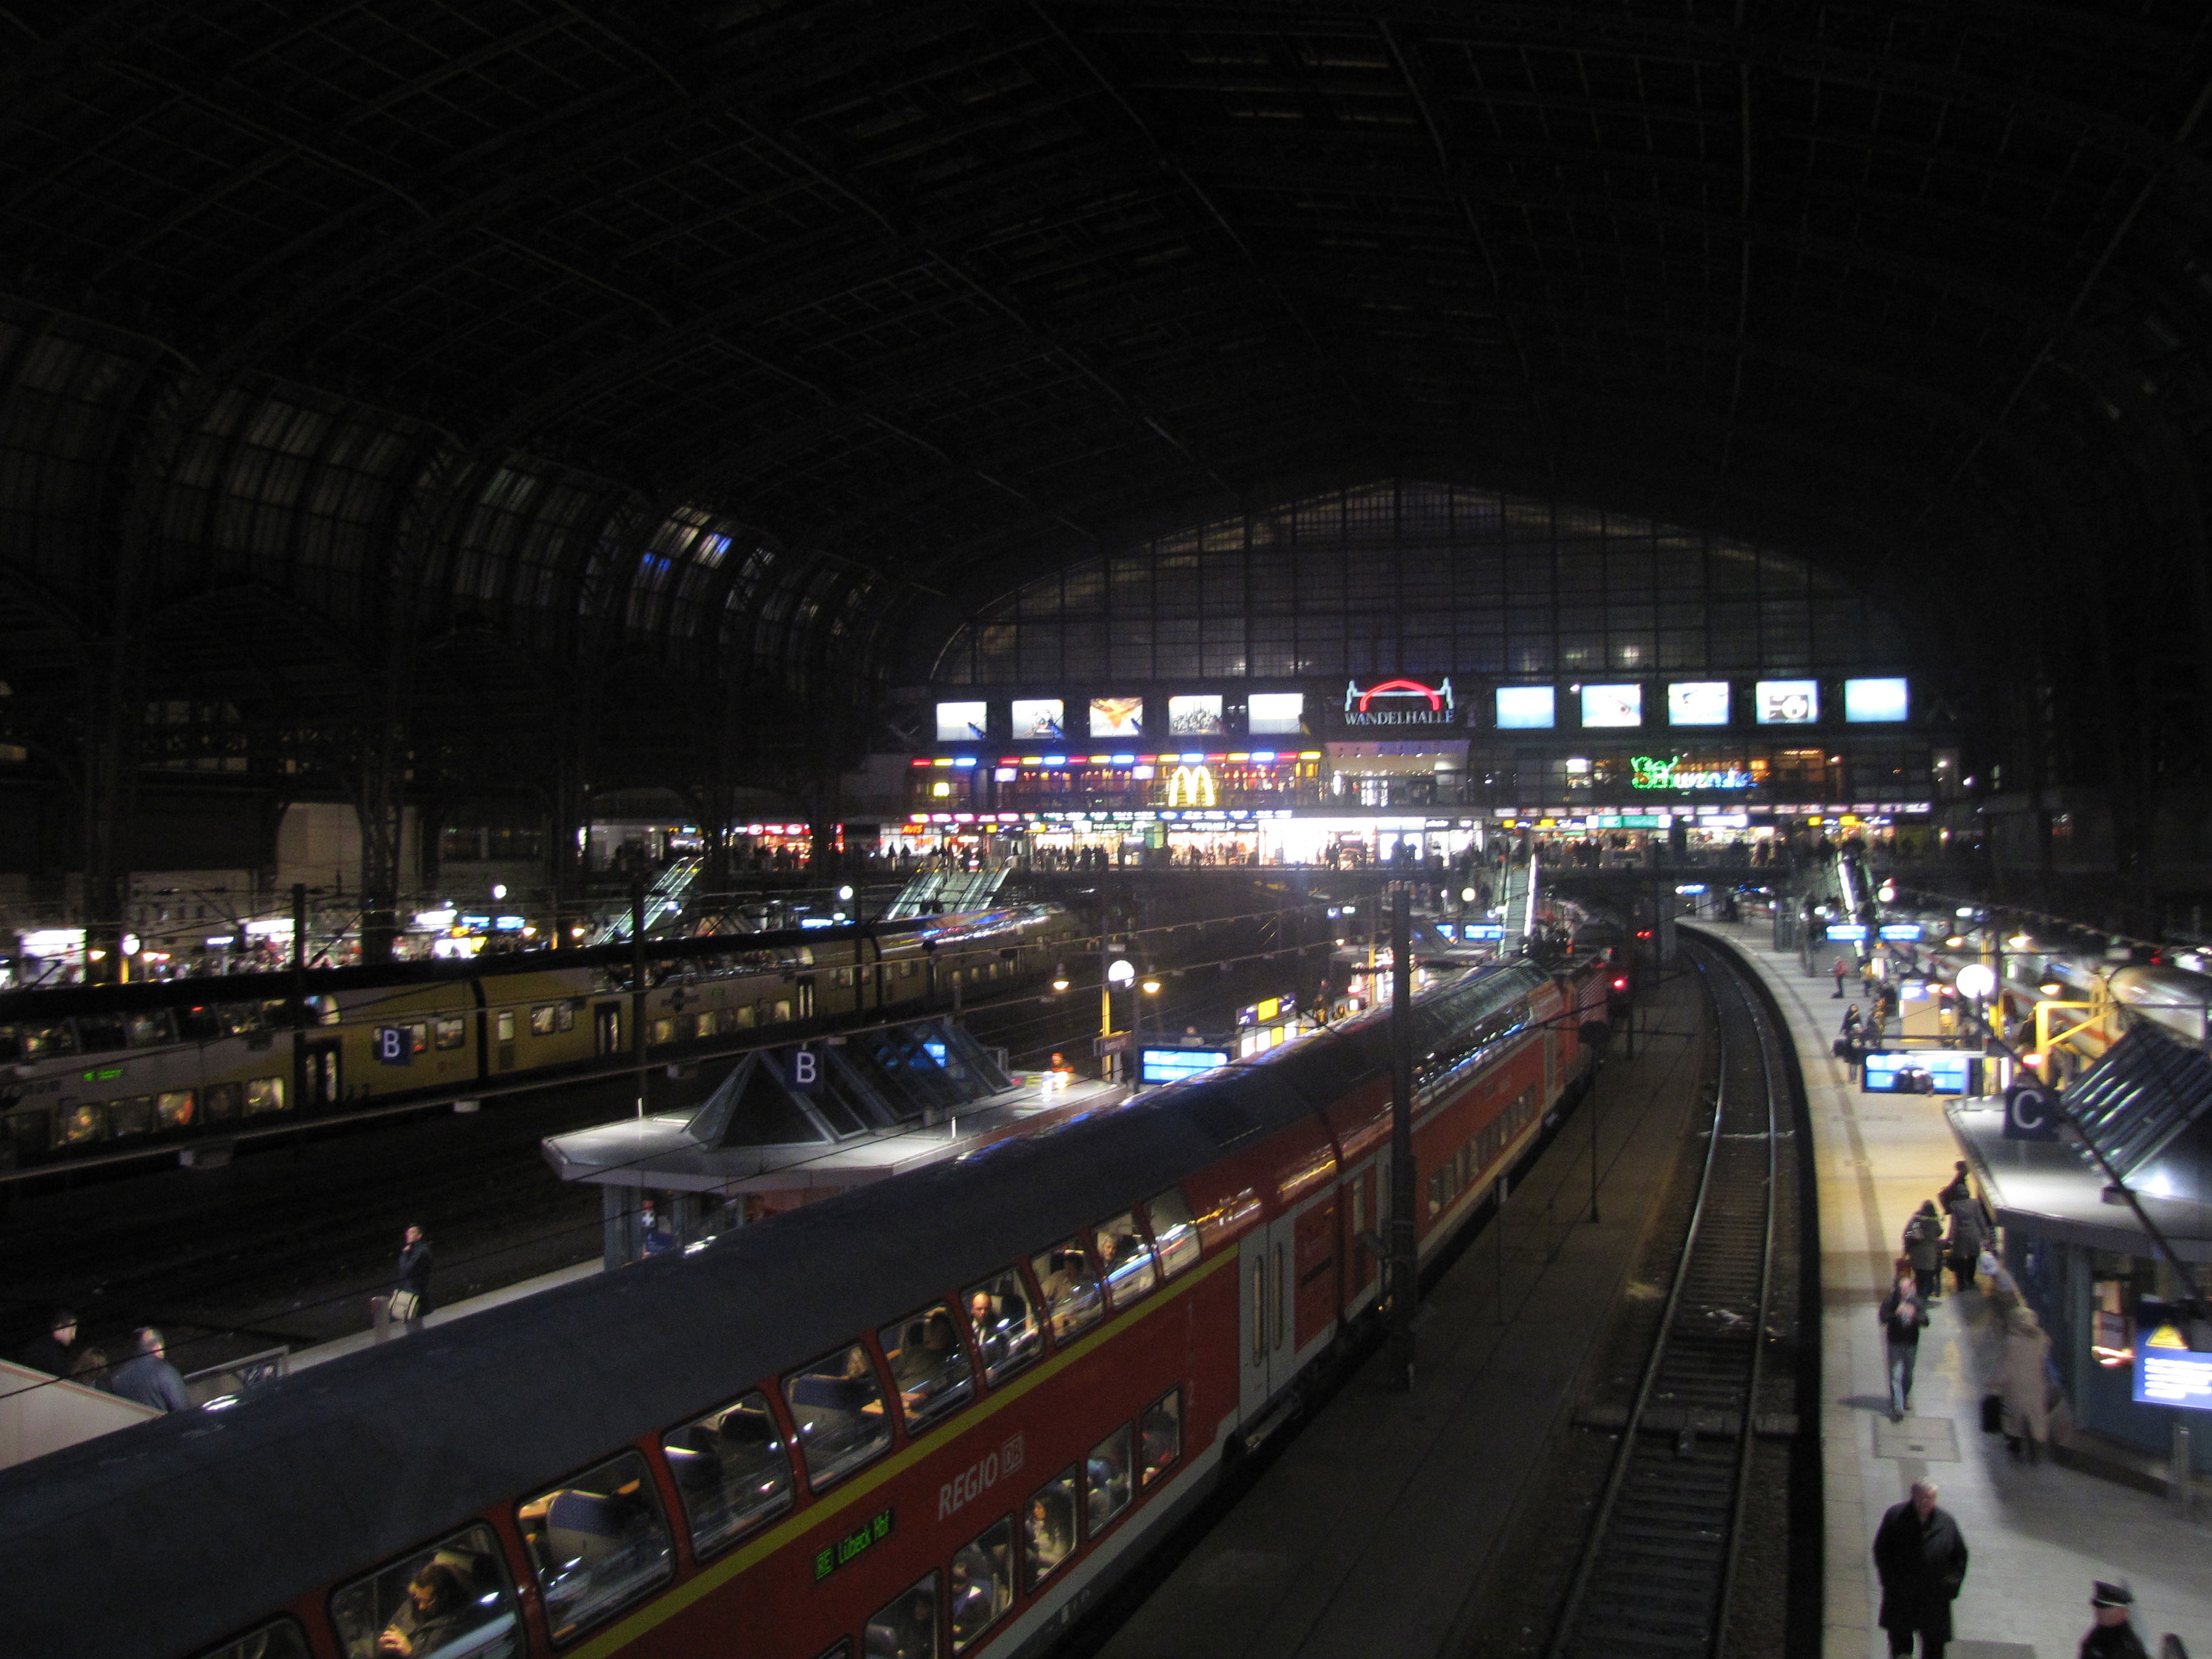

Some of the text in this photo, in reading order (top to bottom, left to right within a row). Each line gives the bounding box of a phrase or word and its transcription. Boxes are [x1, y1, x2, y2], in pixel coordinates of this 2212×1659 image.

[1344, 710, 1454, 725] WANDELHALLE
[902, 824, 923, 834] AVIS
[383, 1030, 400, 1057] B
[797, 1052, 816, 1083] B
[2012, 1090, 2045, 1129] C
[938, 1452, 999, 1521] REGIO
